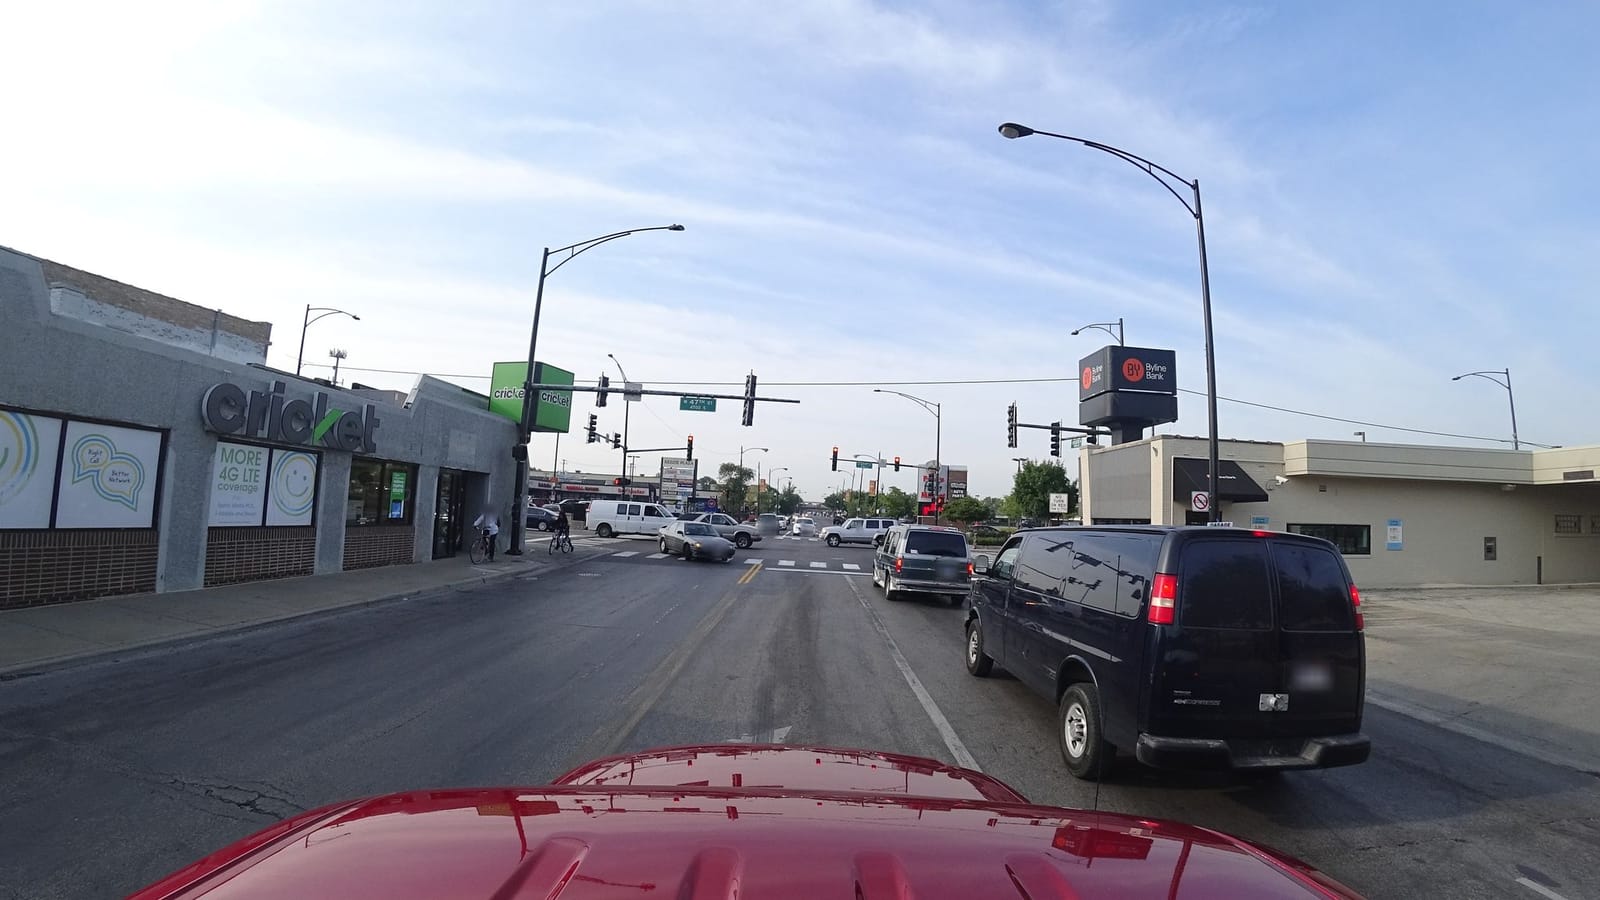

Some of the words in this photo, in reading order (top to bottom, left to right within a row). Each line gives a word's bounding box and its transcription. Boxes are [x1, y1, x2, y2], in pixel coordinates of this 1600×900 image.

[1127, 363, 1141, 376] BY
[1145, 362, 1167, 373] Byline
[1146, 371, 1164, 380] Bank
[493, 386, 526, 399] cricke
[541, 390, 570, 407] cricket
[202, 380, 380, 454] cricket
[220, 447, 262, 466] MORE
[219, 467, 240, 482] 4G
[243, 468, 261, 483] LTE
[217, 483, 259, 495] coverage
